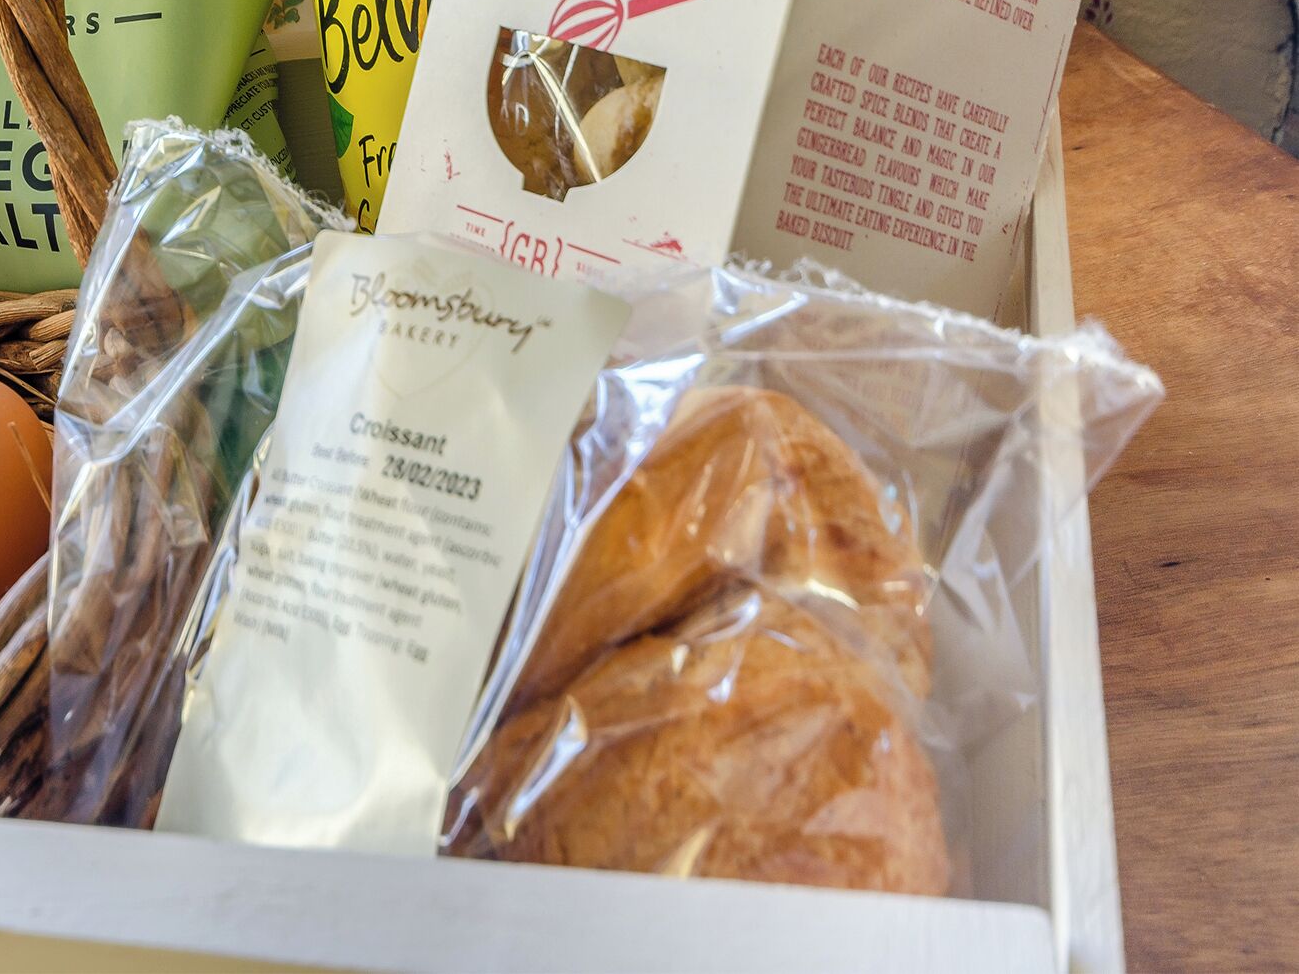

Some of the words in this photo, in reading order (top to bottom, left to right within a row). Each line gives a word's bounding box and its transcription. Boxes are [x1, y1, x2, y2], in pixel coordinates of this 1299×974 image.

[1012, 7, 1034, 32] OVER
[810, 71, 856, 104] CRAFTED
[859, 89, 890, 118] SPICE
[893, 102, 929, 132] BLENDS
[933, 117, 957, 141] THAT
[959, 127, 992, 155] CREATE
[816, 42, 846, 70] EACH
[849, 55, 865, 77] OF
[868, 63, 889, 87] OUR
[892, 72, 932, 104] RECIPES
[935, 89, 960, 114] HAVE
[962, 100, 1009, 133] CAREFULLY
[796, 126, 866, 167] GINGERBREAD
[874, 154, 921, 187] FLAVOURS
[928, 173, 959, 199] WHICH
[965, 186, 990, 211] MAKE
[803, 98, 848, 130] PERFECT
[852, 116, 897, 149] BALANCE
[900, 135, 922, 157] AND
[926, 144, 957, 171] MAGIC
[960, 156, 974, 177] IN
[978, 163, 996, 186] OUR
[790, 154, 817, 180] YOUR
[821, 165, 875, 199] TASTEBUDS
[877, 184, 912, 212] TINGLE
[913, 197, 934, 219] AND
[936, 204, 964, 229] GIVES
[966, 214, 983, 236] YOU
[805, 190, 855, 222] ULTIMATE
[855, 206, 892, 234] EATING
[892, 218, 946, 252] EXPERIENCE
[350, 272, 533, 355] Bloomsbury
[379, 319, 461, 349] BAKERY
[350, 411, 448, 456] Croissant
